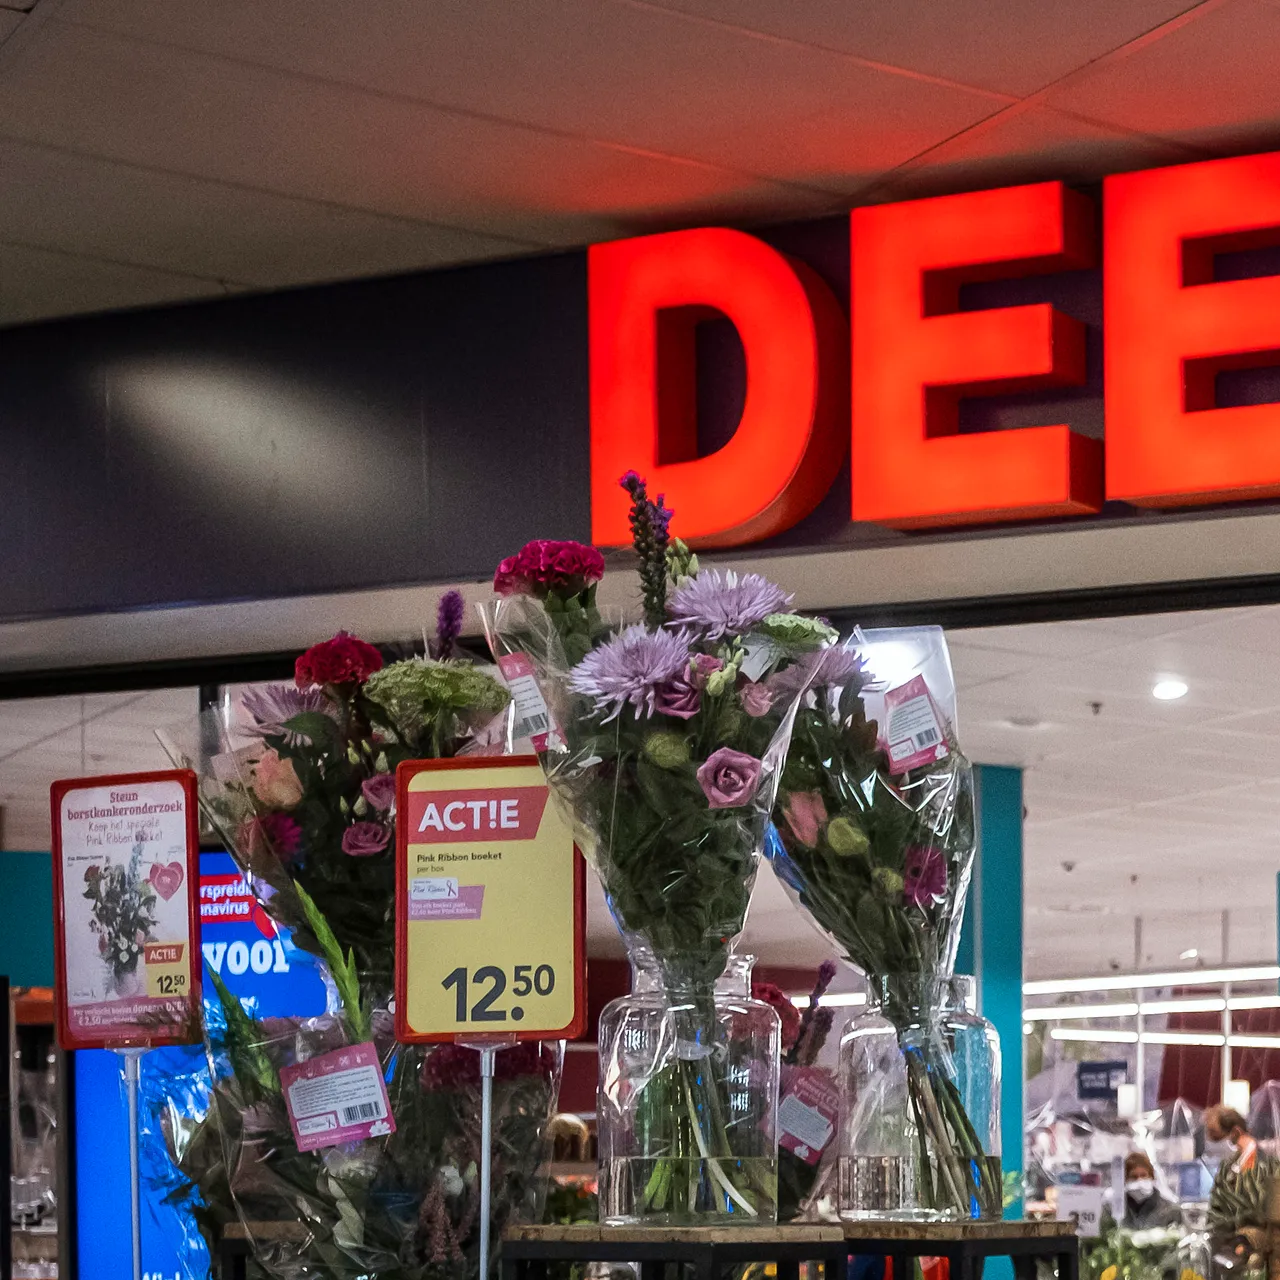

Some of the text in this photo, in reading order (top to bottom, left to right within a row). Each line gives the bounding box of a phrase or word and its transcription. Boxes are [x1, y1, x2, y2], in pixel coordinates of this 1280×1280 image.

[110, 791, 138, 803] Steun
[67, 800, 183, 820] borstkankeronderzoek
[417, 852, 502, 863] Pink Ribbon boeket
[416, 865, 444, 874] per bos
[442, 964, 555, 1022] 12.50
